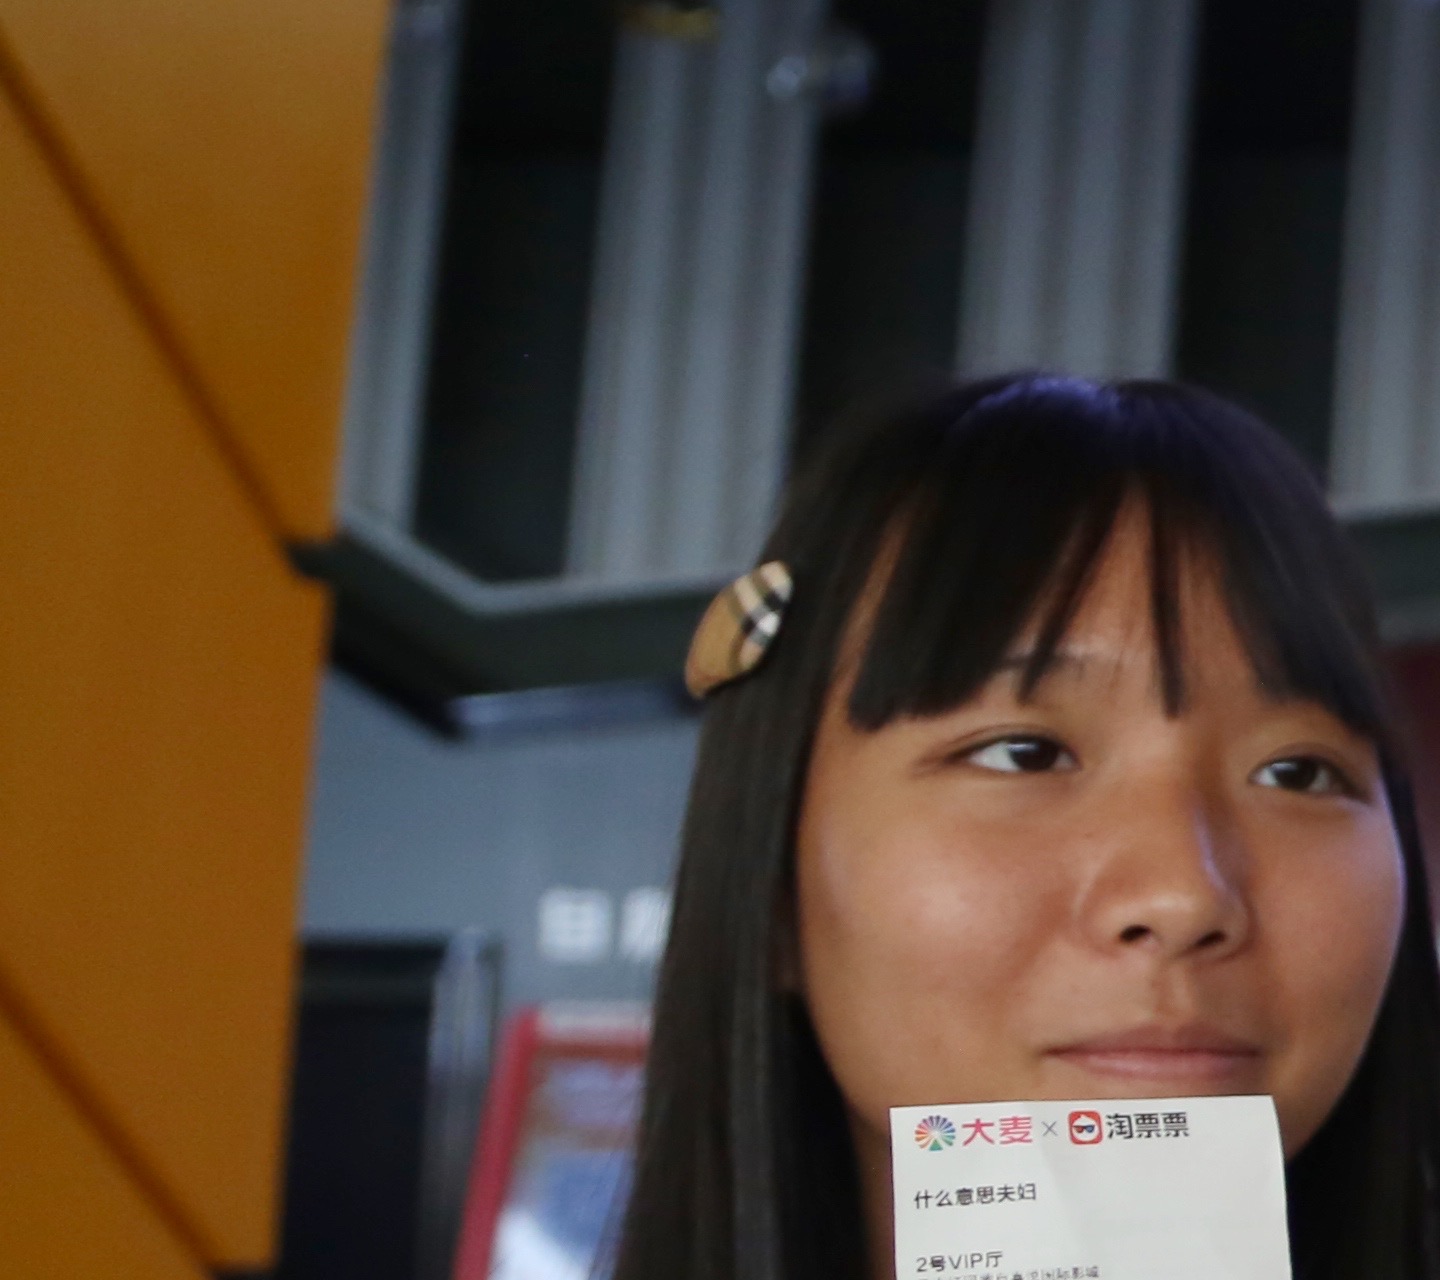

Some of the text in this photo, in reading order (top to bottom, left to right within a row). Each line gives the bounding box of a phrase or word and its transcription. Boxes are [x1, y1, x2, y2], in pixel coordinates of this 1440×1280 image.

[961, 1112, 1190, 1147] 大麦 淘票票
[914, 1183, 1037, 1209] 什么意思夫妇
[916, 1251, 1003, 1273] 2号VIP厅
